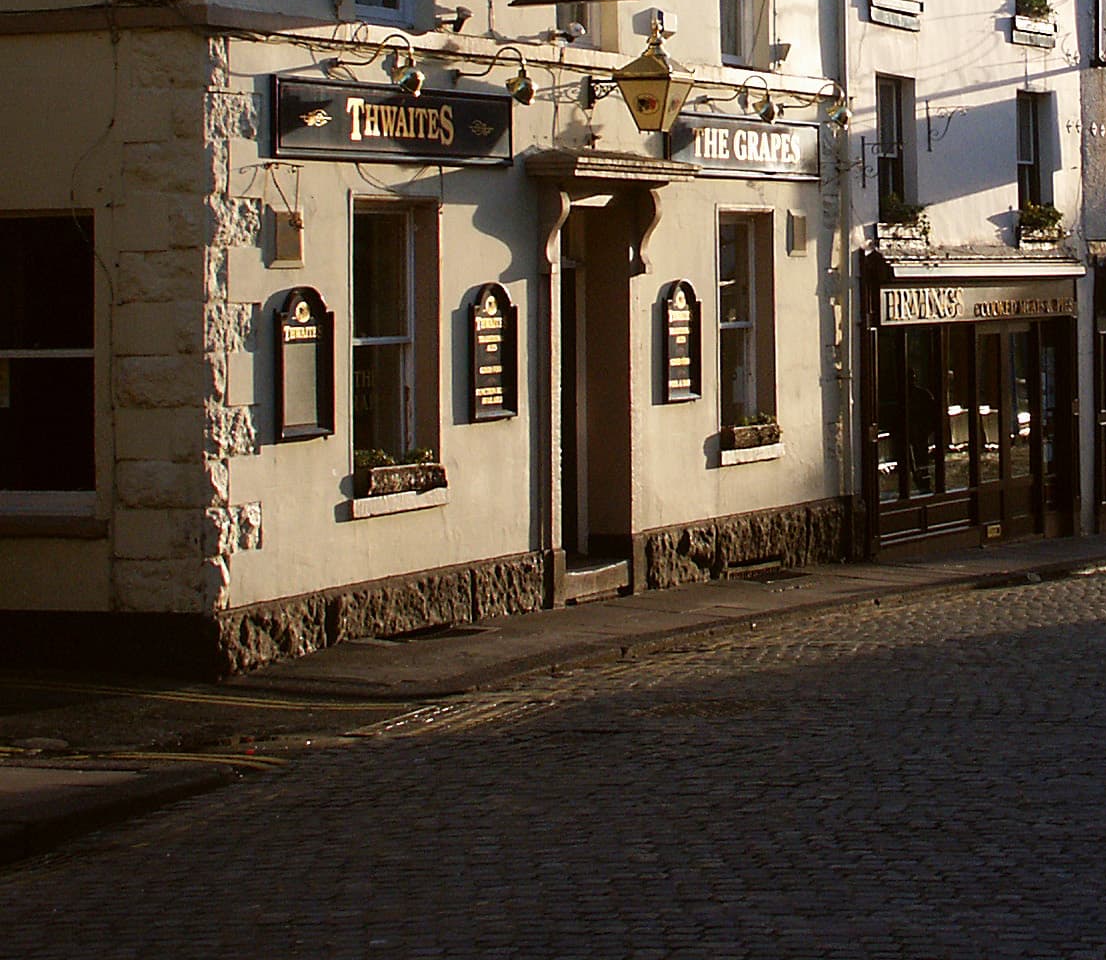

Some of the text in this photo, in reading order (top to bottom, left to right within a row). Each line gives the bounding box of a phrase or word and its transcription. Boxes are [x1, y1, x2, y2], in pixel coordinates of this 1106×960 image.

[346, 97, 454, 146] THWAITES
[692, 127, 801, 164] THE GRAPES
[886, 287, 964, 321] IRVINGS
